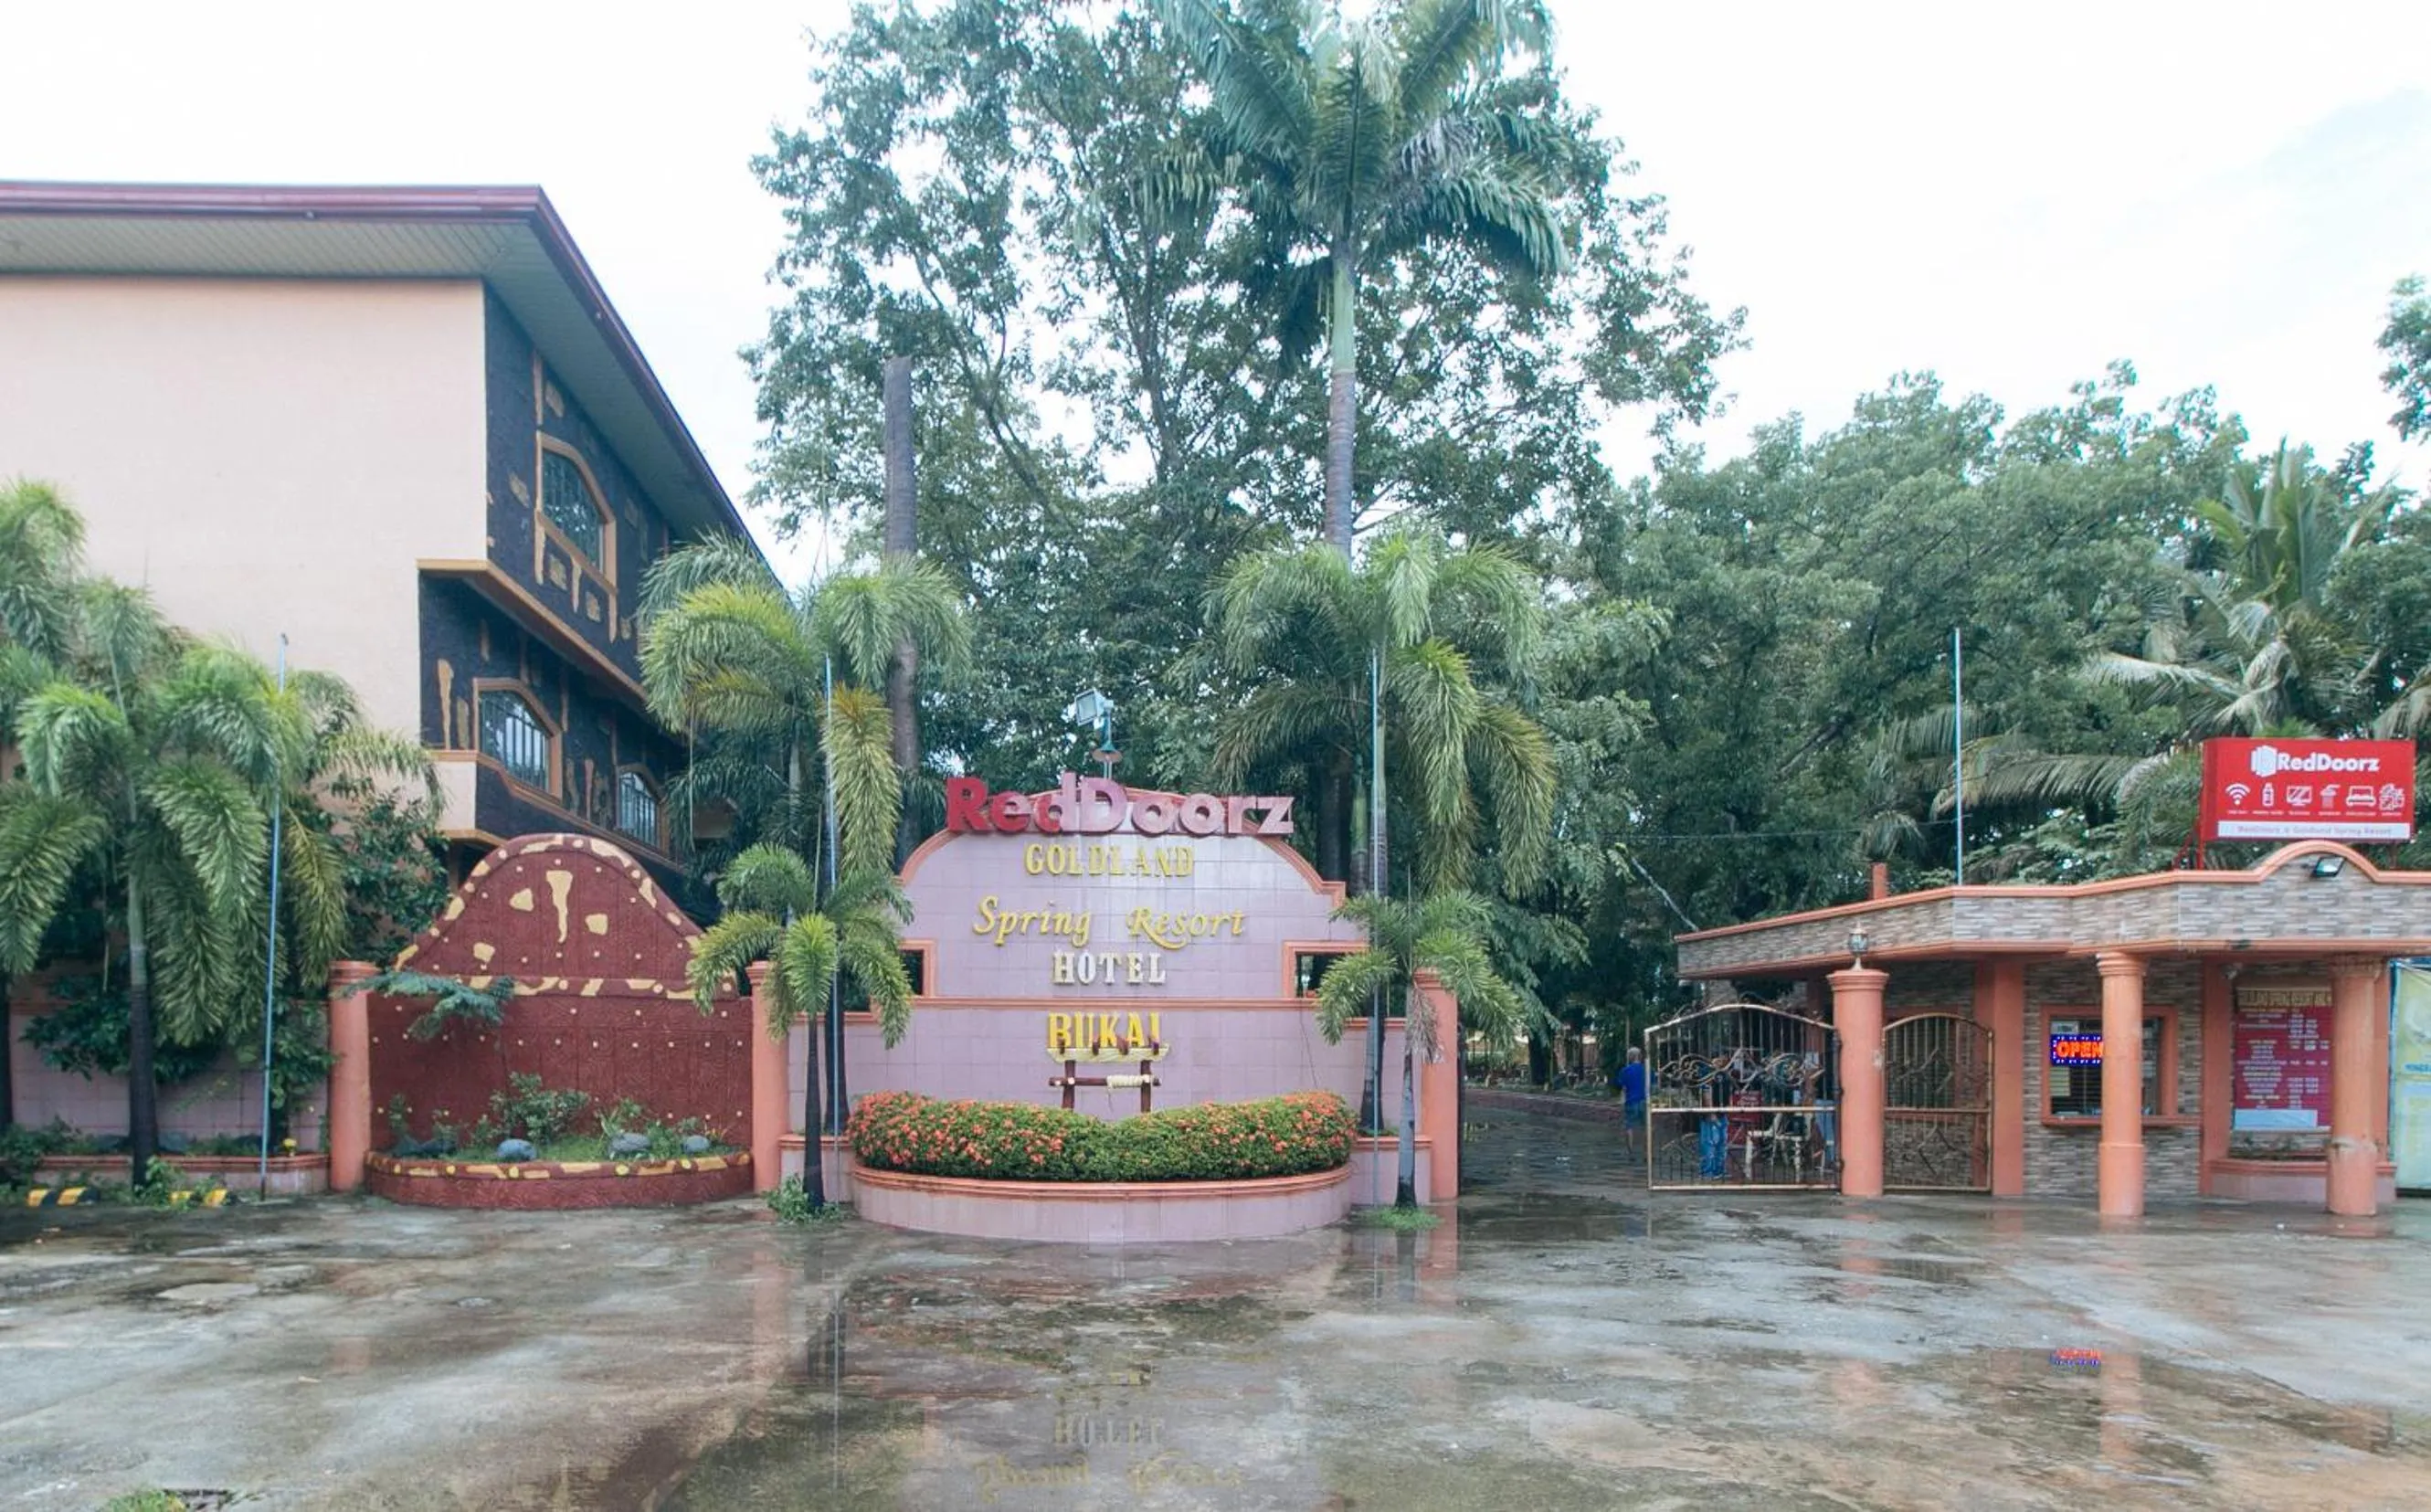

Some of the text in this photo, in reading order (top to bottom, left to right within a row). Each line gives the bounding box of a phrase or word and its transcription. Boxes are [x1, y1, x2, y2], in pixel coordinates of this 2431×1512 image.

[2278, 752, 2380, 772] RedDoorz
[946, 771, 1295, 836] RedDoorz
[1024, 842, 1195, 877] GOLDLAND
[972, 894, 1245, 949] Spring Resort
[1052, 952, 1167, 985] HOTEL
[2056, 1041, 2104, 1058] OPEN
